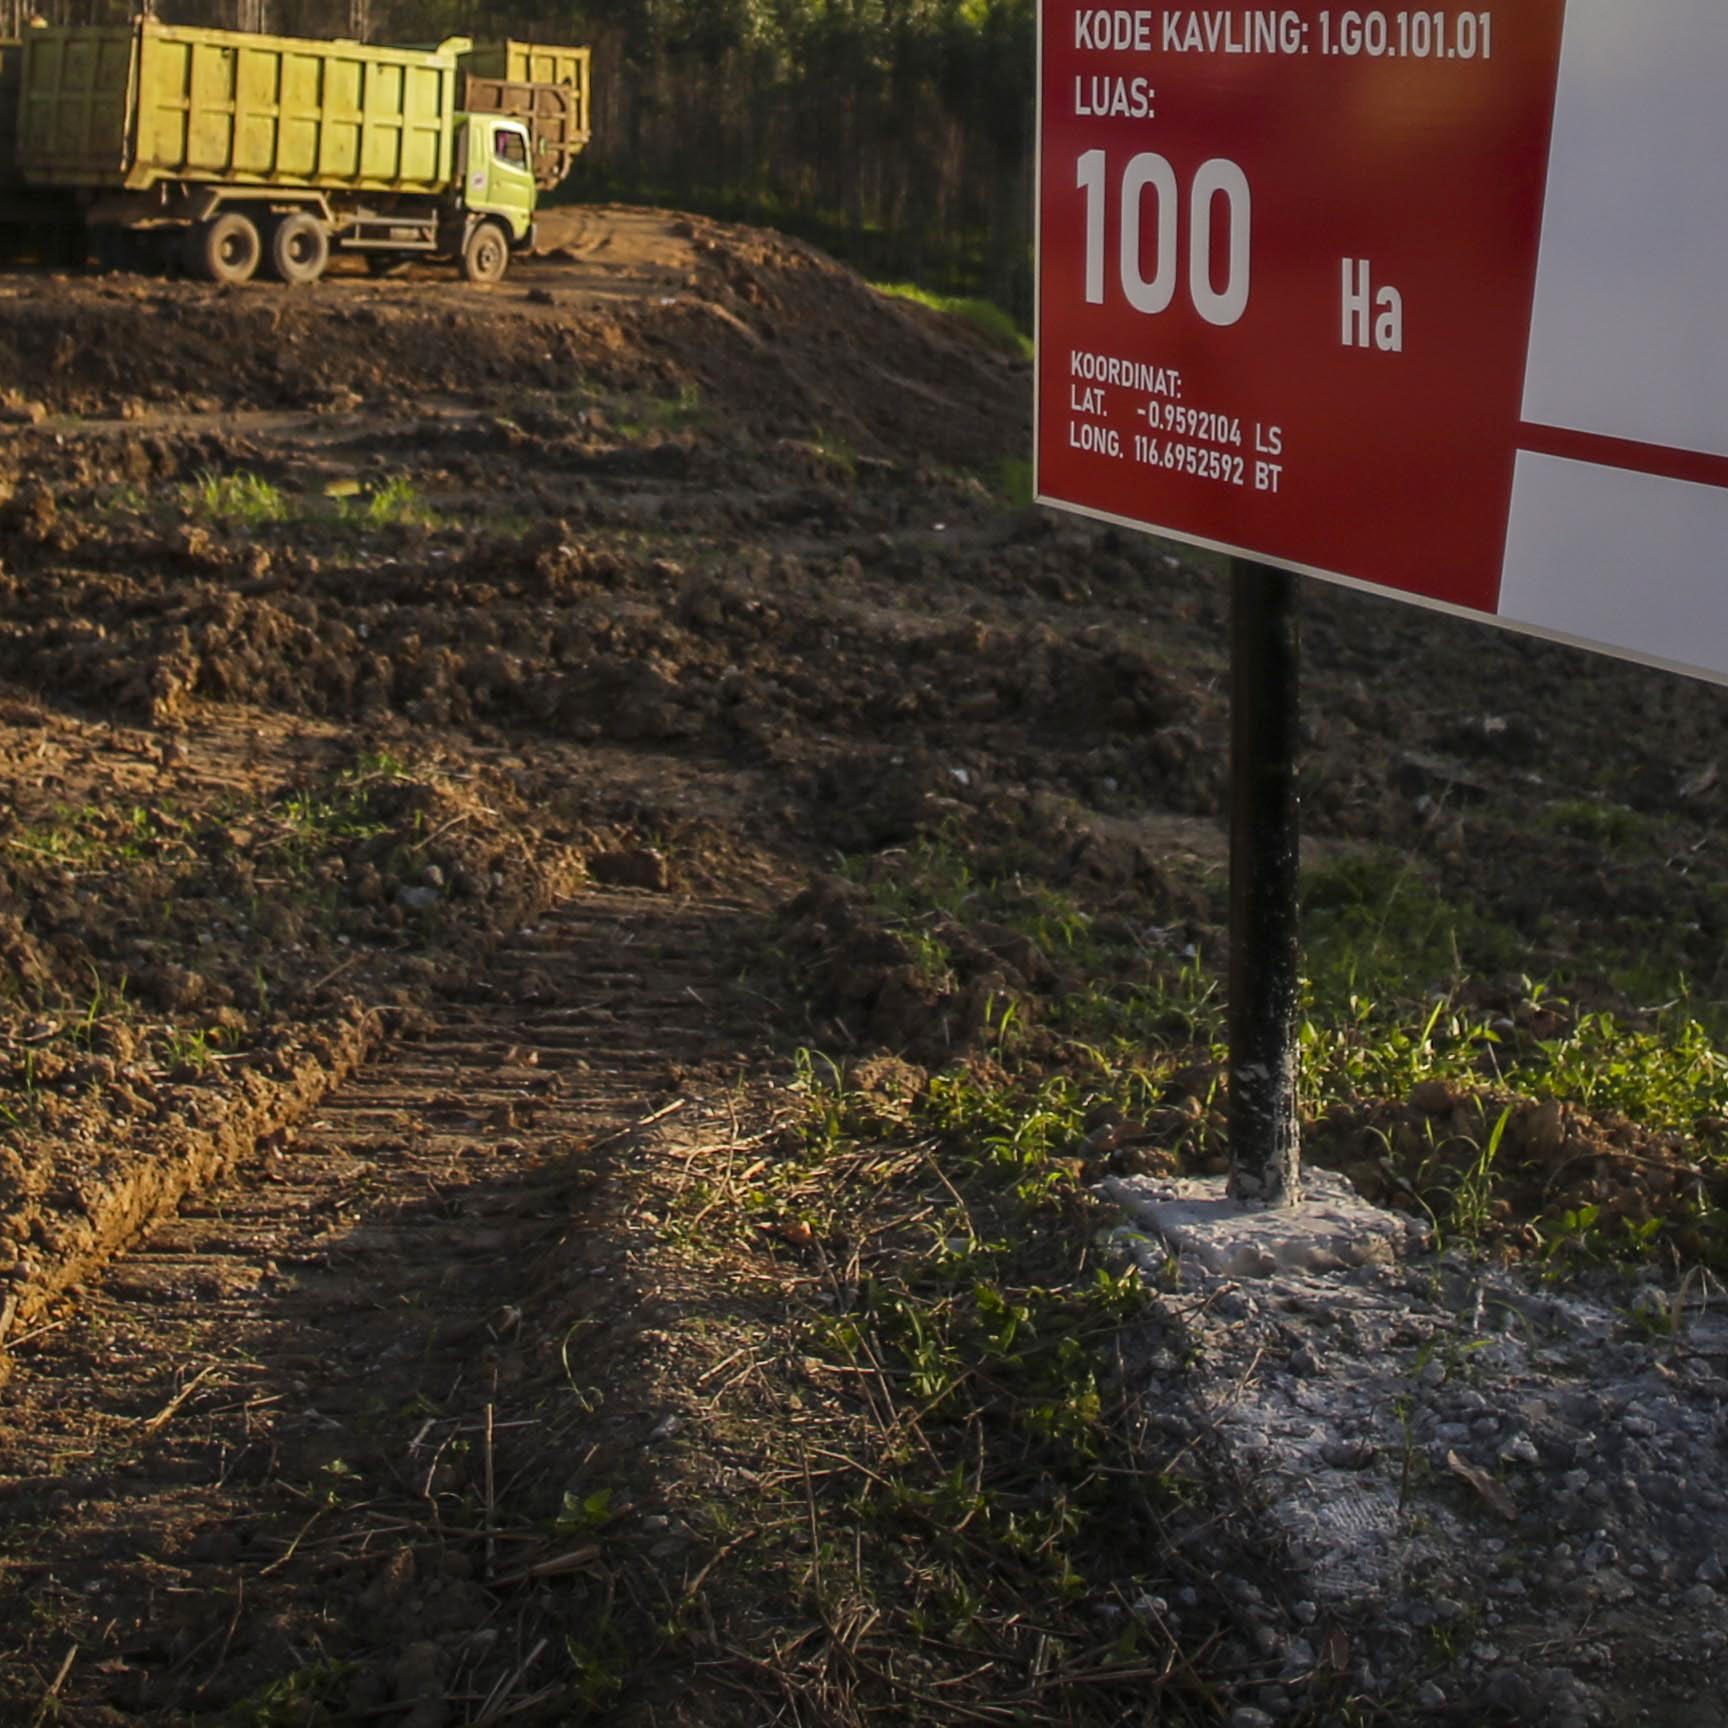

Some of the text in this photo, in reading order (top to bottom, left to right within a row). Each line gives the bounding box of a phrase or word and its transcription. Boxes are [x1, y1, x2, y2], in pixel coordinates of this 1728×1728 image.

[1075, 10, 1152, 51] KODE
[1162, 10, 1310, 55] KAVLING:
[1075, 75, 1155, 118] LUAS:
[1076, 149, 1252, 327] 100
[1341, 257, 1403, 353] Ha
[1071, 350, 1182, 399] KOORDINAT:
[1071, 383, 1283, 456] LAT. -0.9592104 LS
[1069, 420, 1283, 493] LONG. 116.6952592 BT
